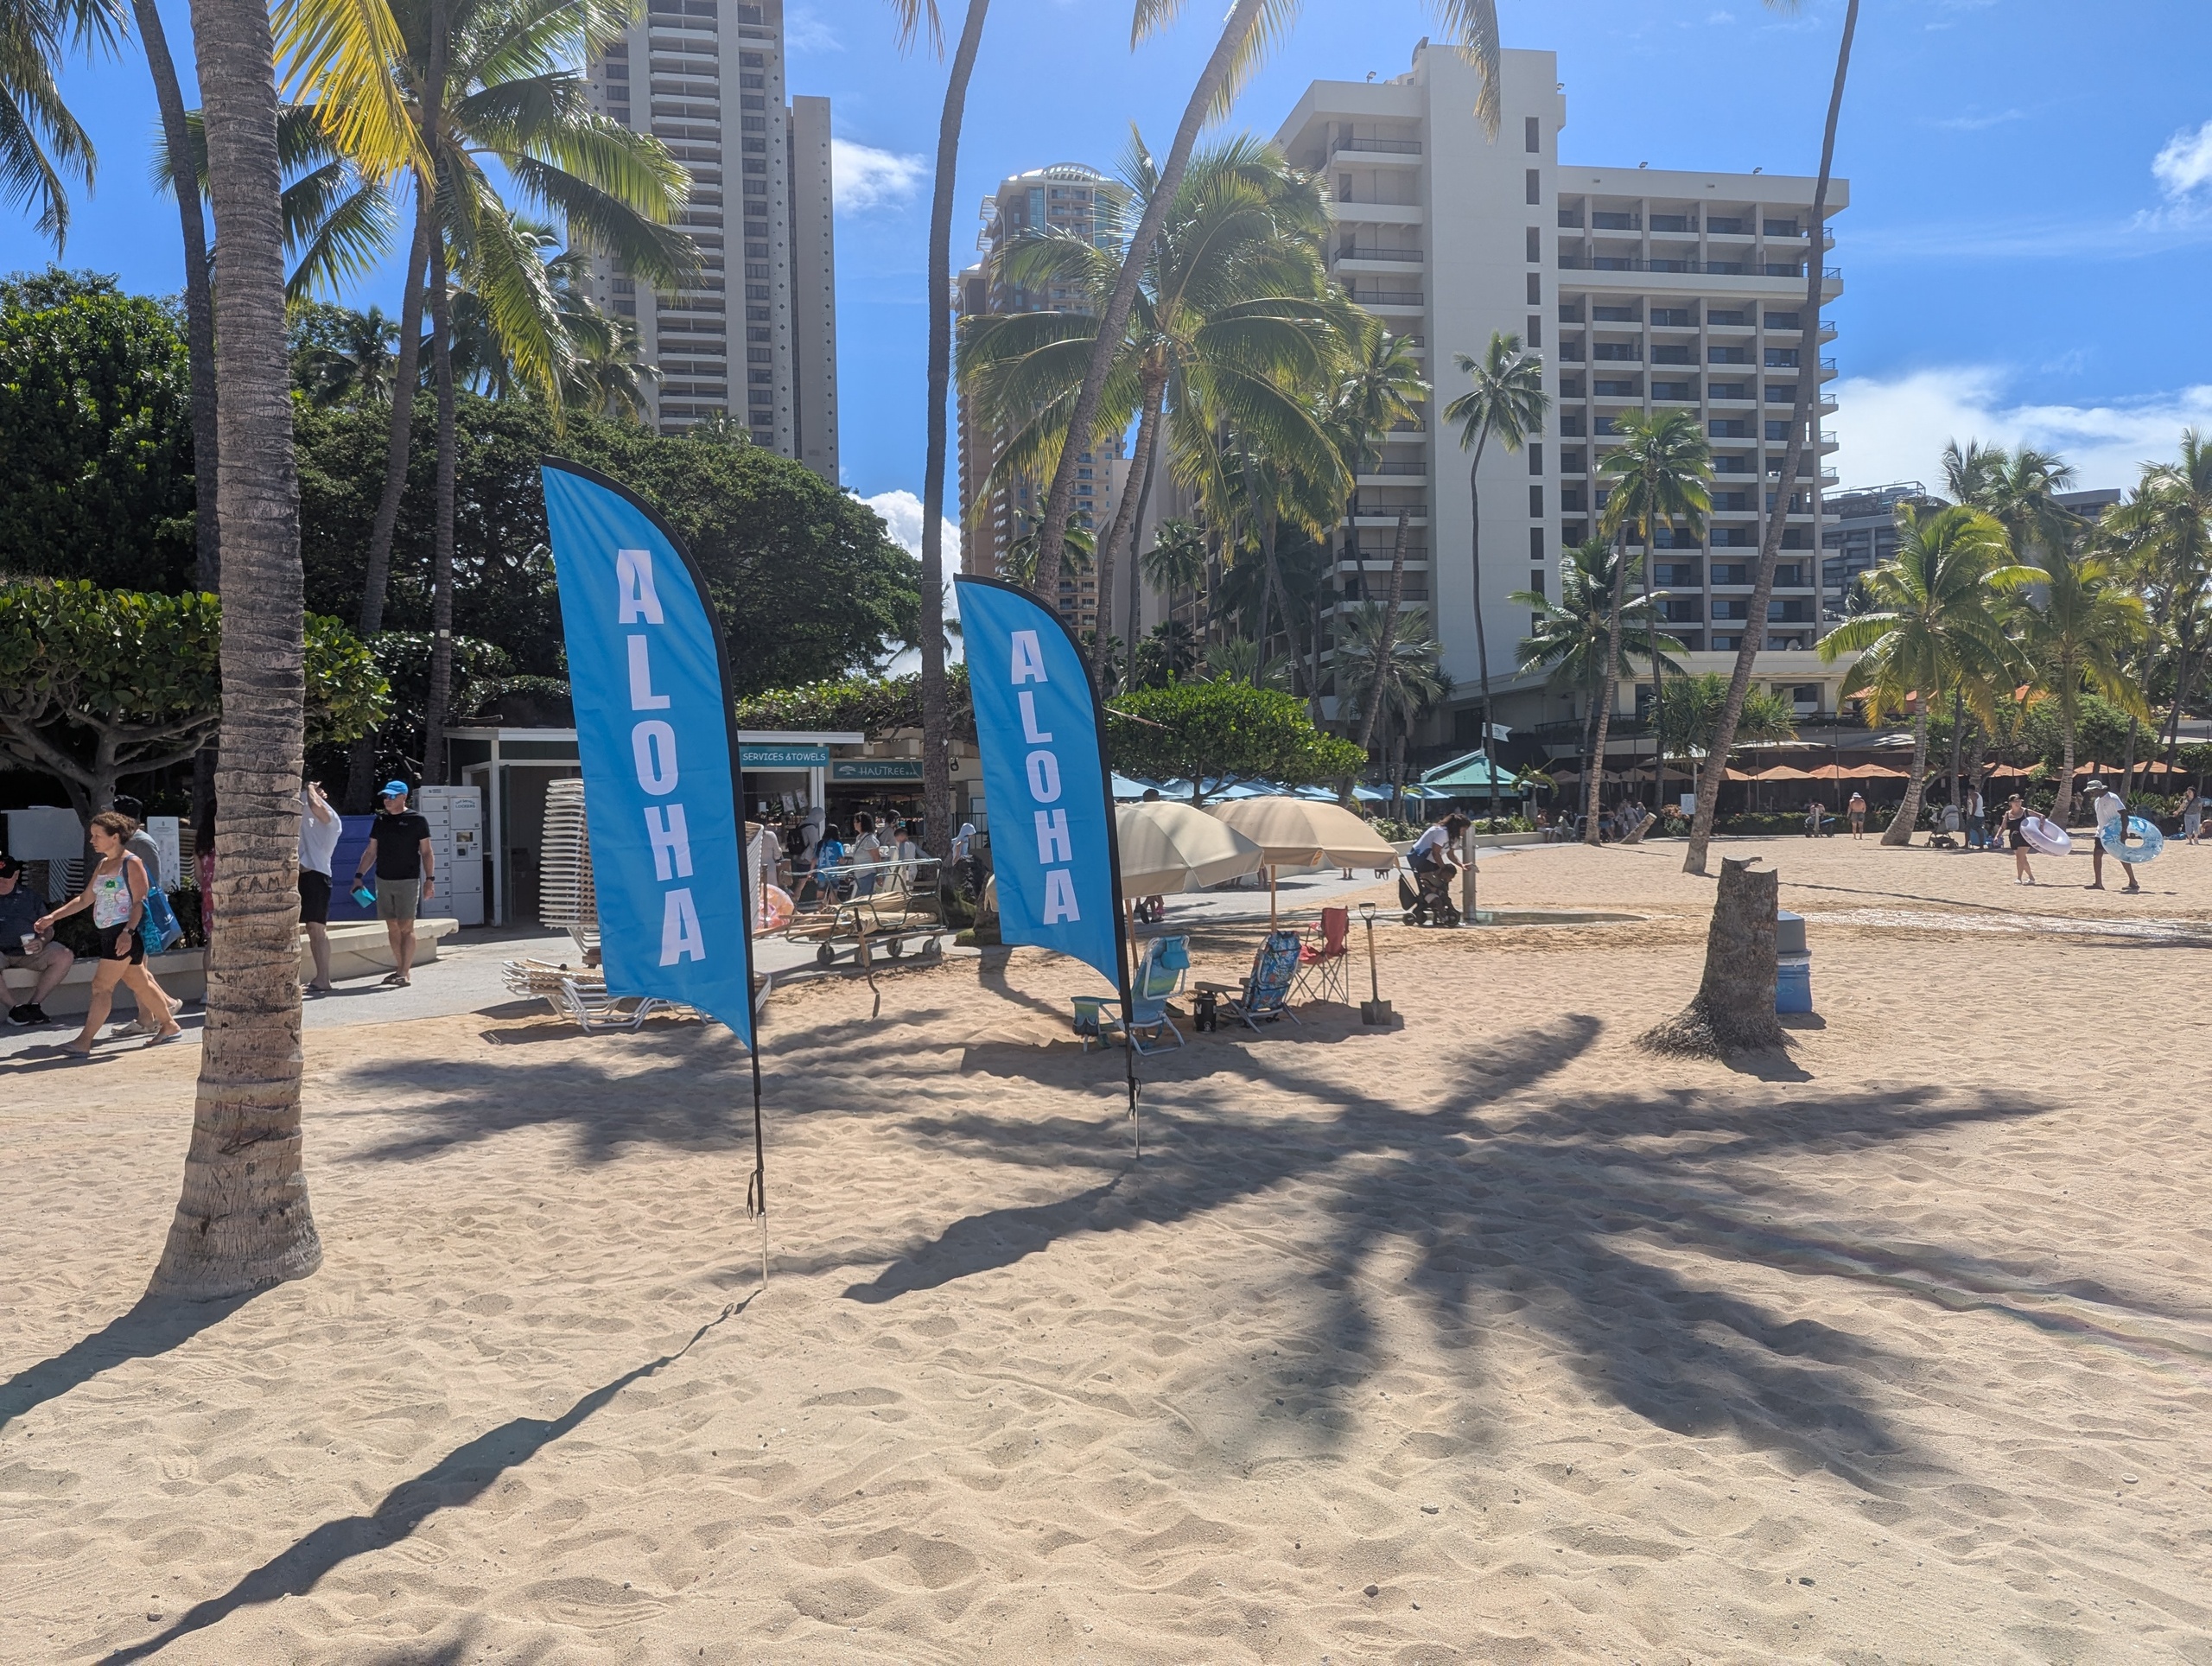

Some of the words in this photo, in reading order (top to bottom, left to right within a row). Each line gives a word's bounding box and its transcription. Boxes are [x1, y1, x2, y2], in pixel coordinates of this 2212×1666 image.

[616, 549, 707, 968] ALOHA
[742, 753, 784, 761] SERVICES
[1011, 630, 1081, 925] ALOHA
